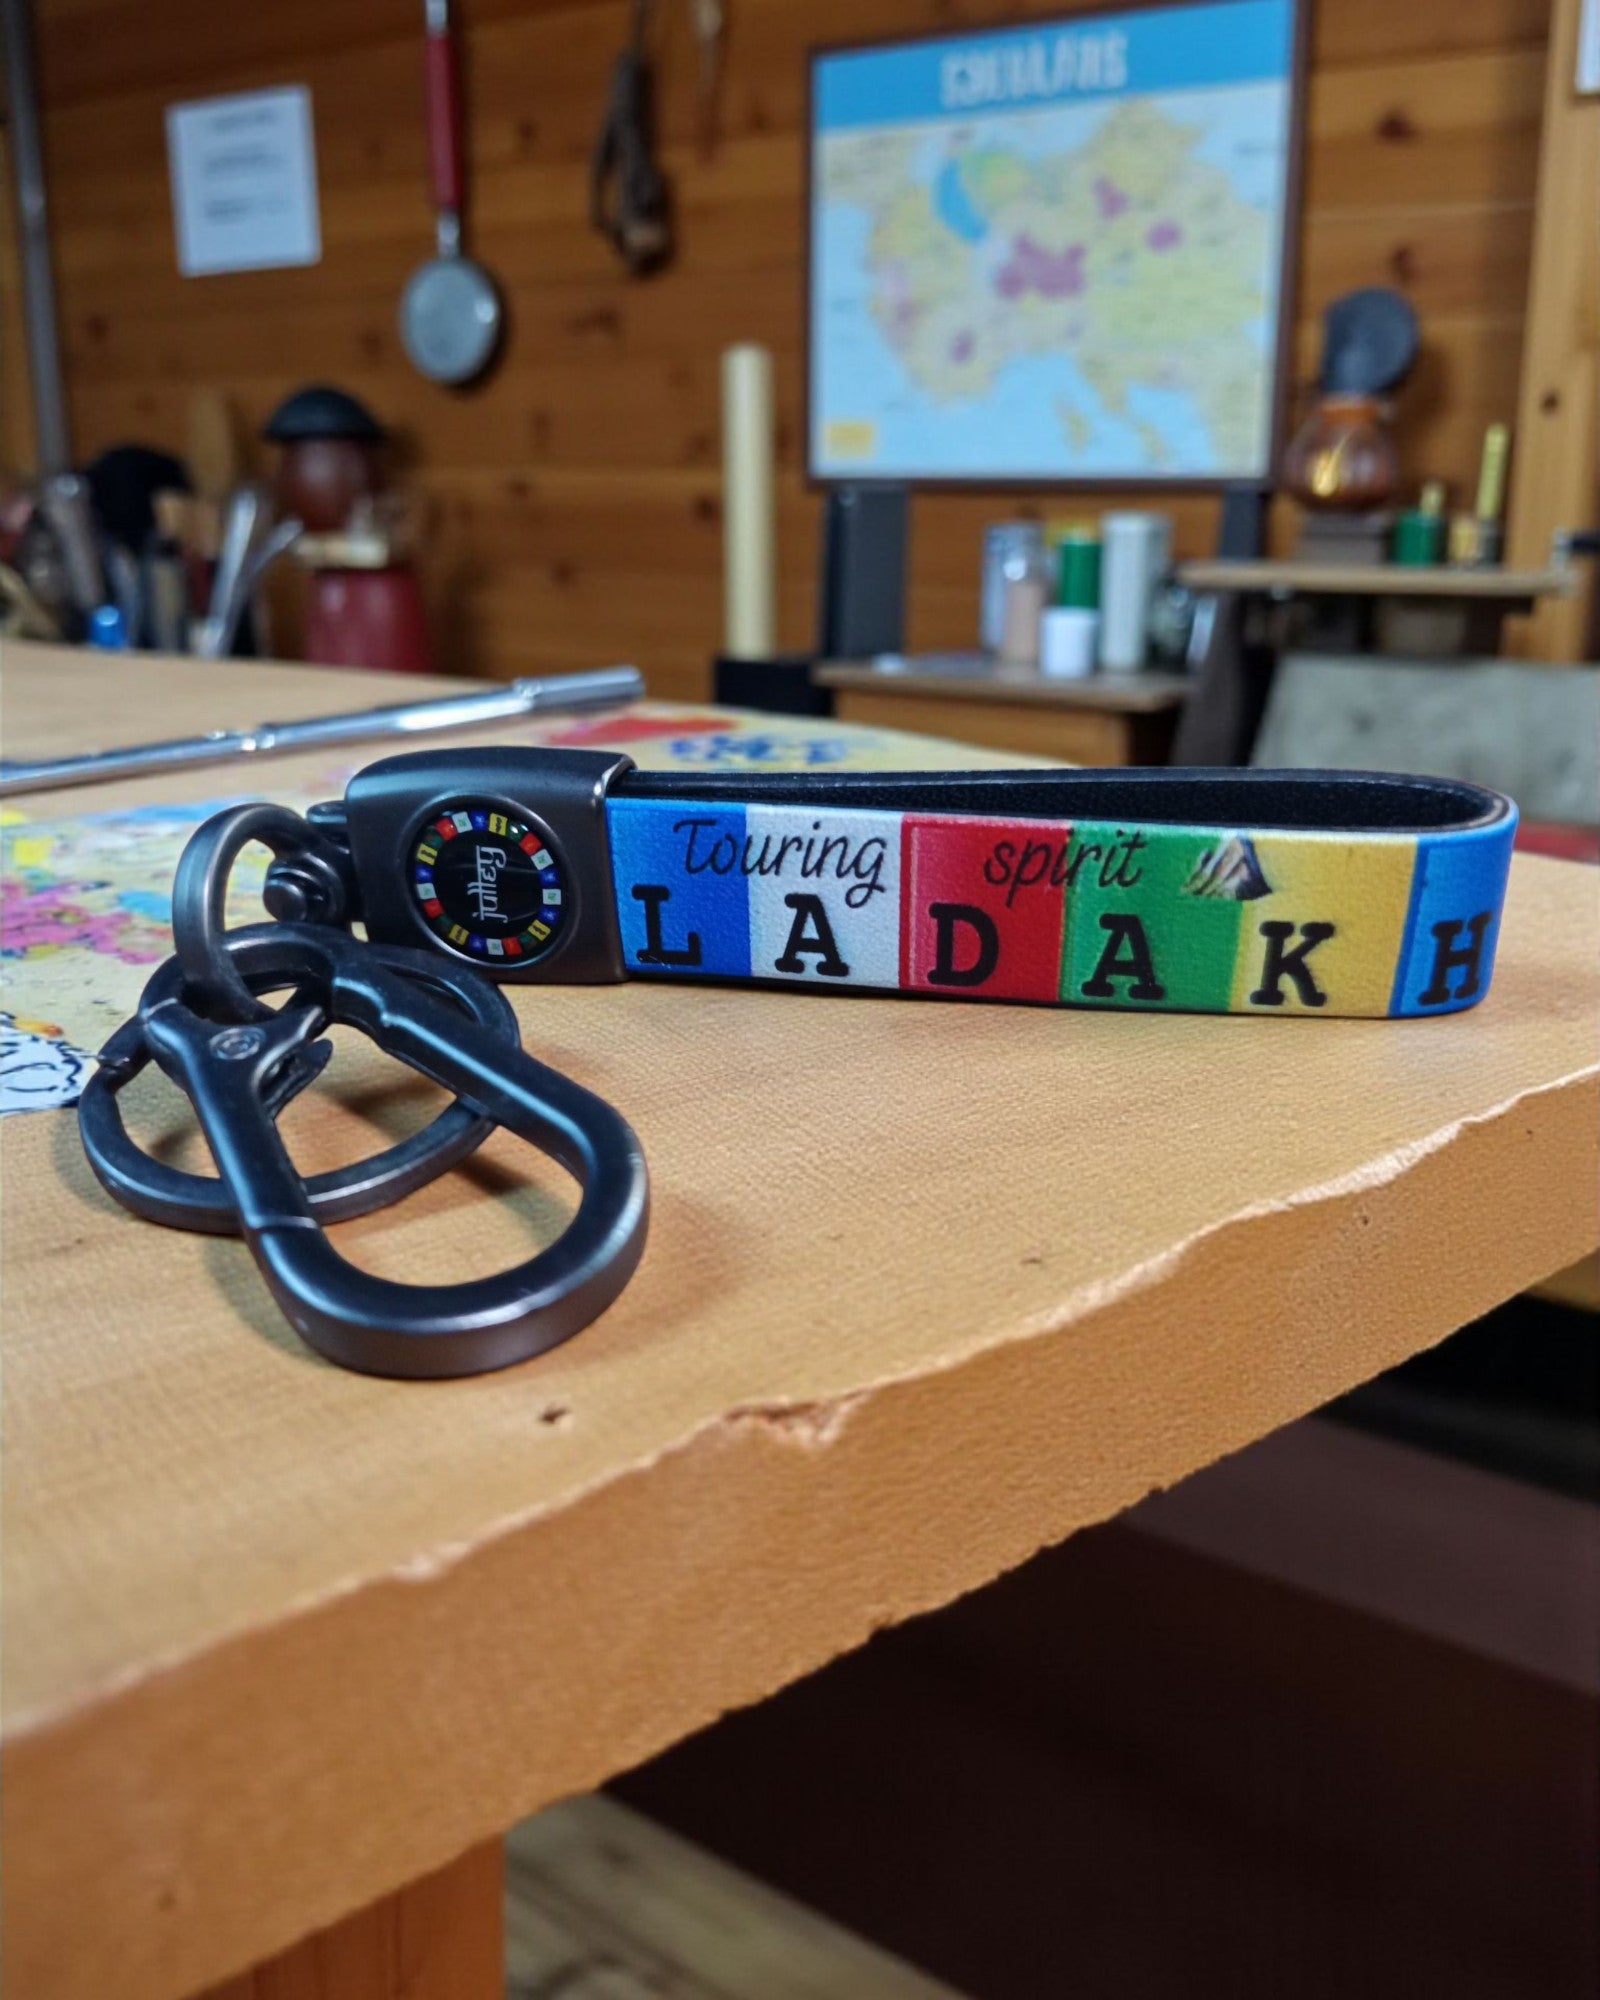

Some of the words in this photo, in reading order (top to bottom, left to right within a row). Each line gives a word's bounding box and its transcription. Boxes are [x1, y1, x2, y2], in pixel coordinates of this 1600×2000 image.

[673, 819, 886, 909] Touring
[982, 827, 1148, 908] spirit
[631, 884, 1492, 1007] LADAKH
